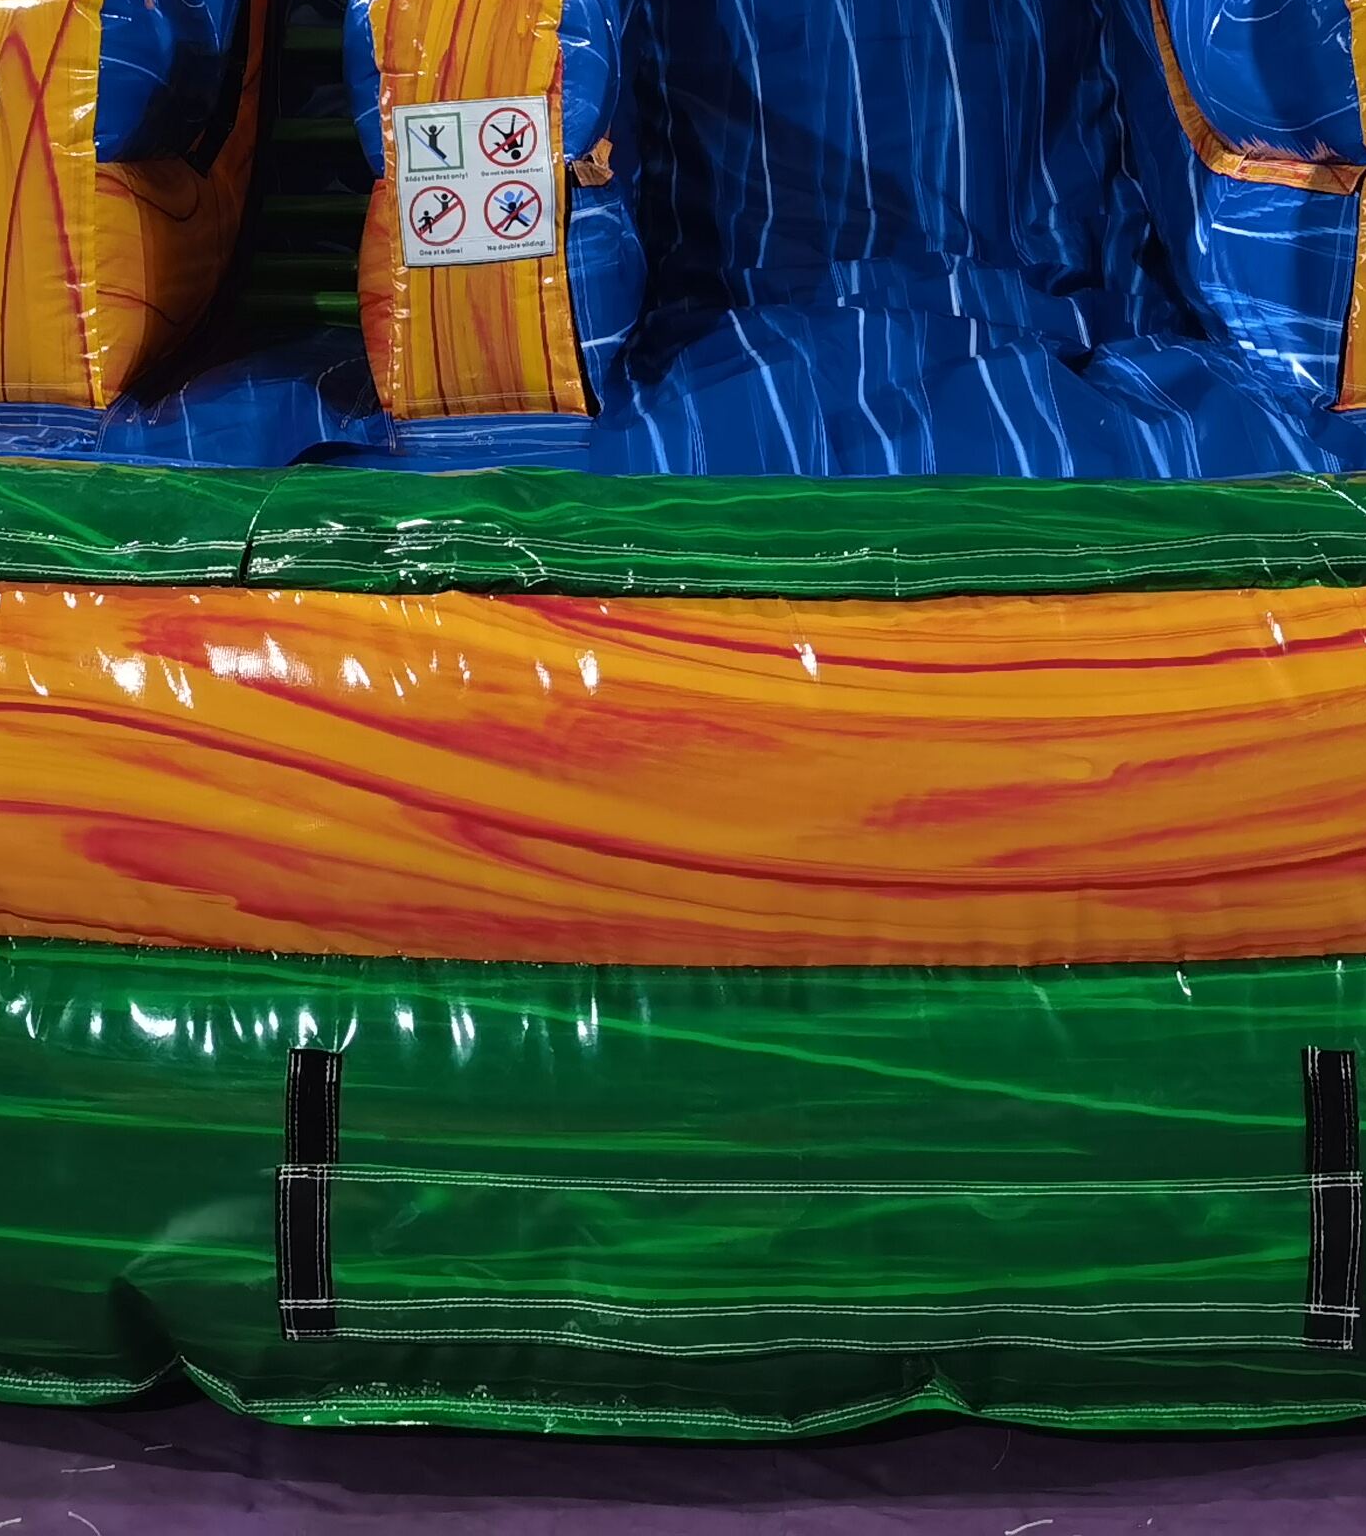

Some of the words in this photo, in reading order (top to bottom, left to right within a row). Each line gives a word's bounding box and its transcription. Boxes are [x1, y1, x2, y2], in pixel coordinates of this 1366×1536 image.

[422, 174, 435, 182] feet
[451, 171, 468, 180] only!
[445, 247, 463, 255] time!
[498, 242, 520, 251] double
